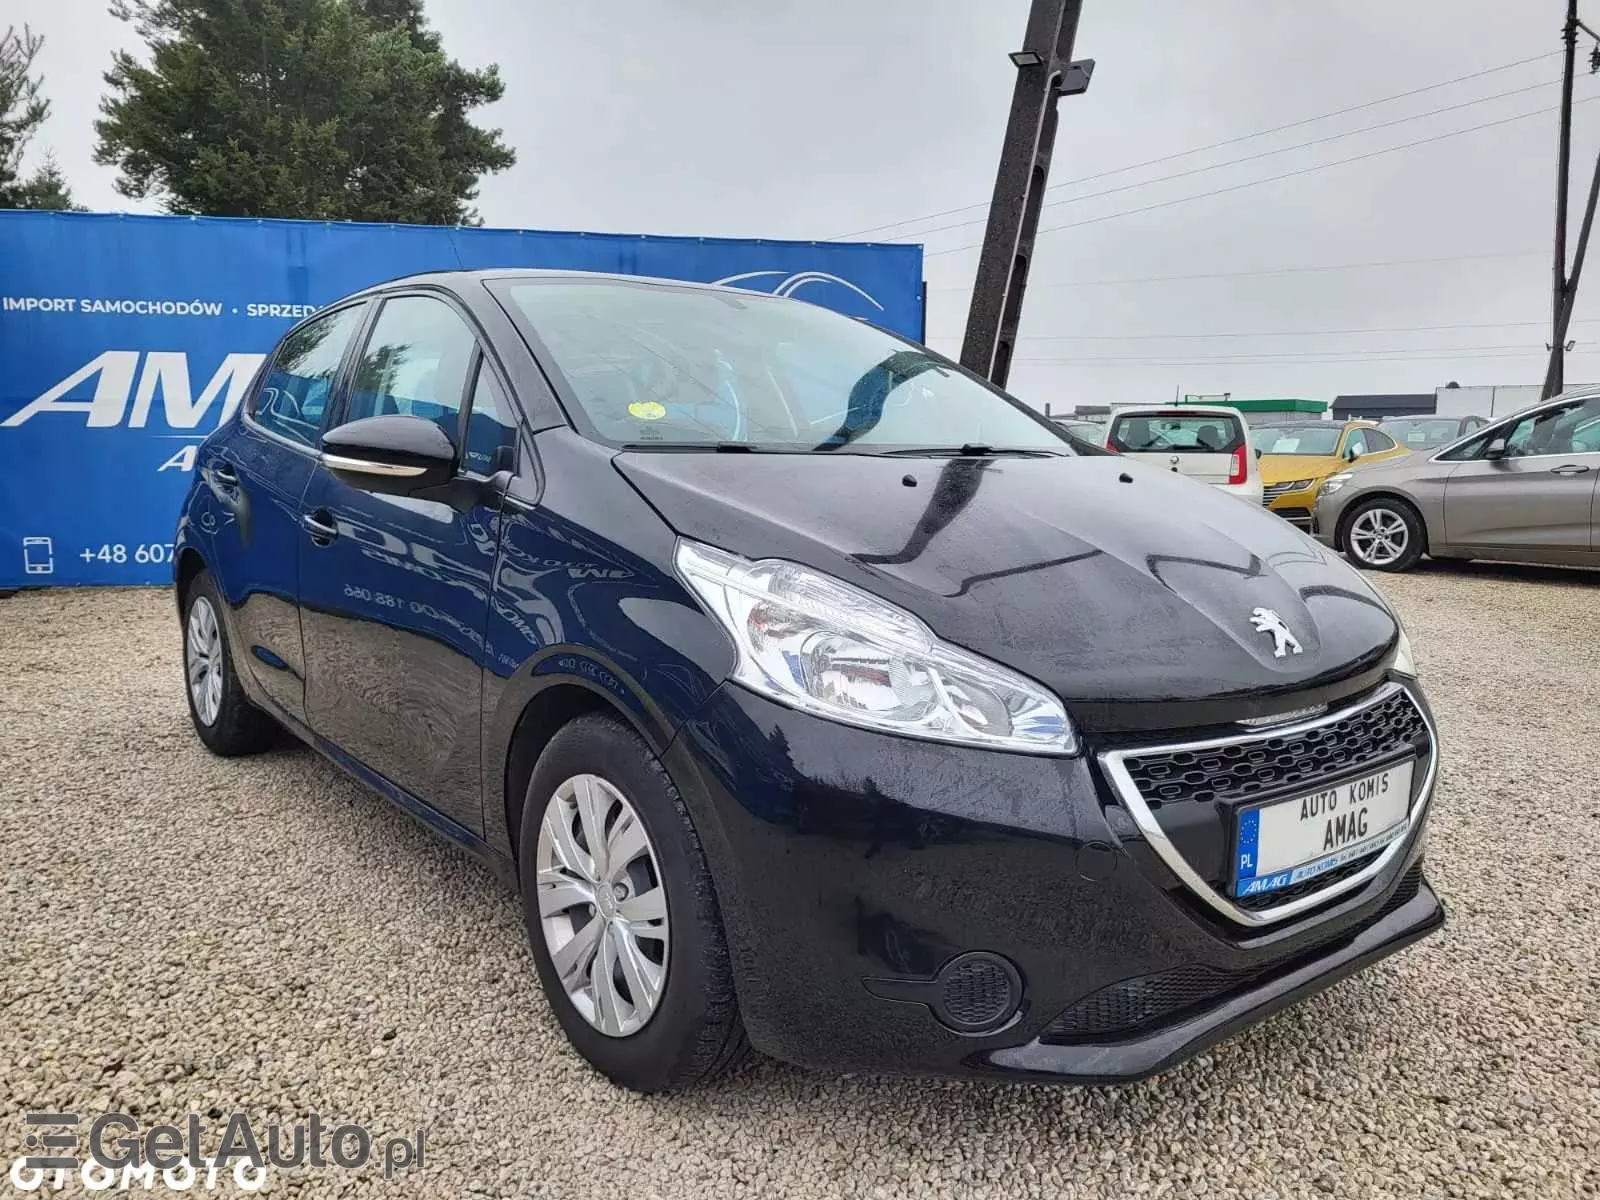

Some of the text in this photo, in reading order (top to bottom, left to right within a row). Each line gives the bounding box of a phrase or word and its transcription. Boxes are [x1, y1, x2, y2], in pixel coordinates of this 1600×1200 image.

[3, 297, 323, 317] IMPORT SAMOCHODÓW SPRZED
[80, 544, 174, 563] +48 607
[1300, 773, 1389, 821] AUTO KOMIS
[1324, 808, 1368, 851] AMAG
[1240, 853, 1253, 869] PL
[1243, 873, 1288, 895] AMAG
